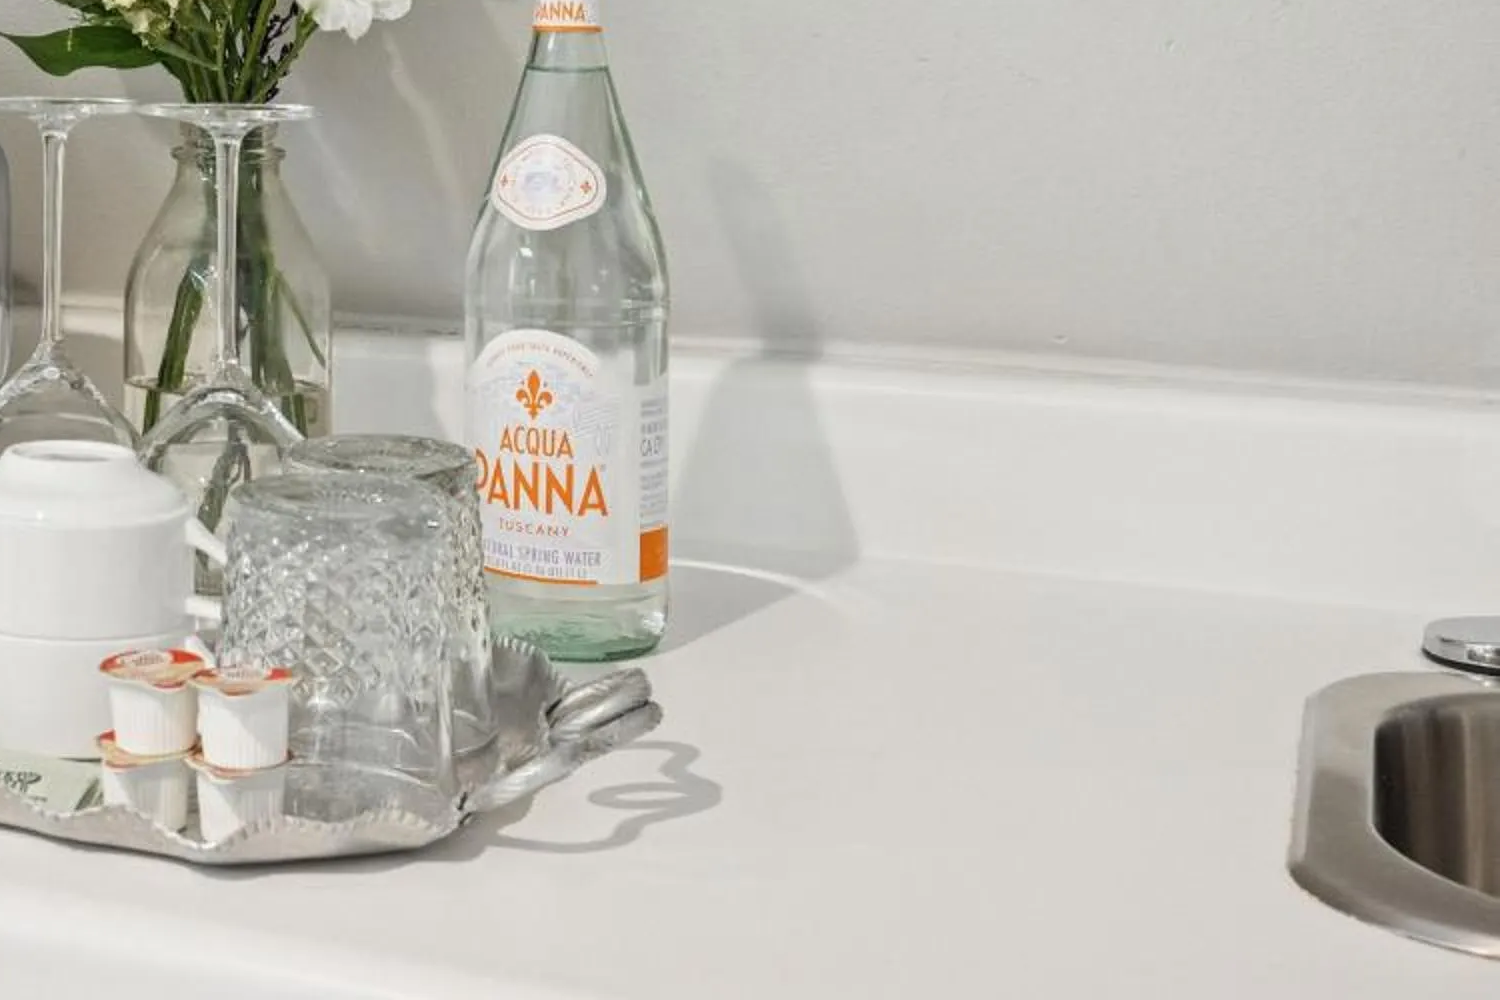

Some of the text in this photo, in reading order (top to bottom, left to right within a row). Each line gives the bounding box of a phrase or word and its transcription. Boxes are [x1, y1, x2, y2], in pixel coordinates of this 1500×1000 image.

[536, 1, 586, 22] ANNA
[499, 424, 574, 459] ACQUA
[499, 517, 570, 537] TUSCANY
[563, 550, 602, 568] WATER
